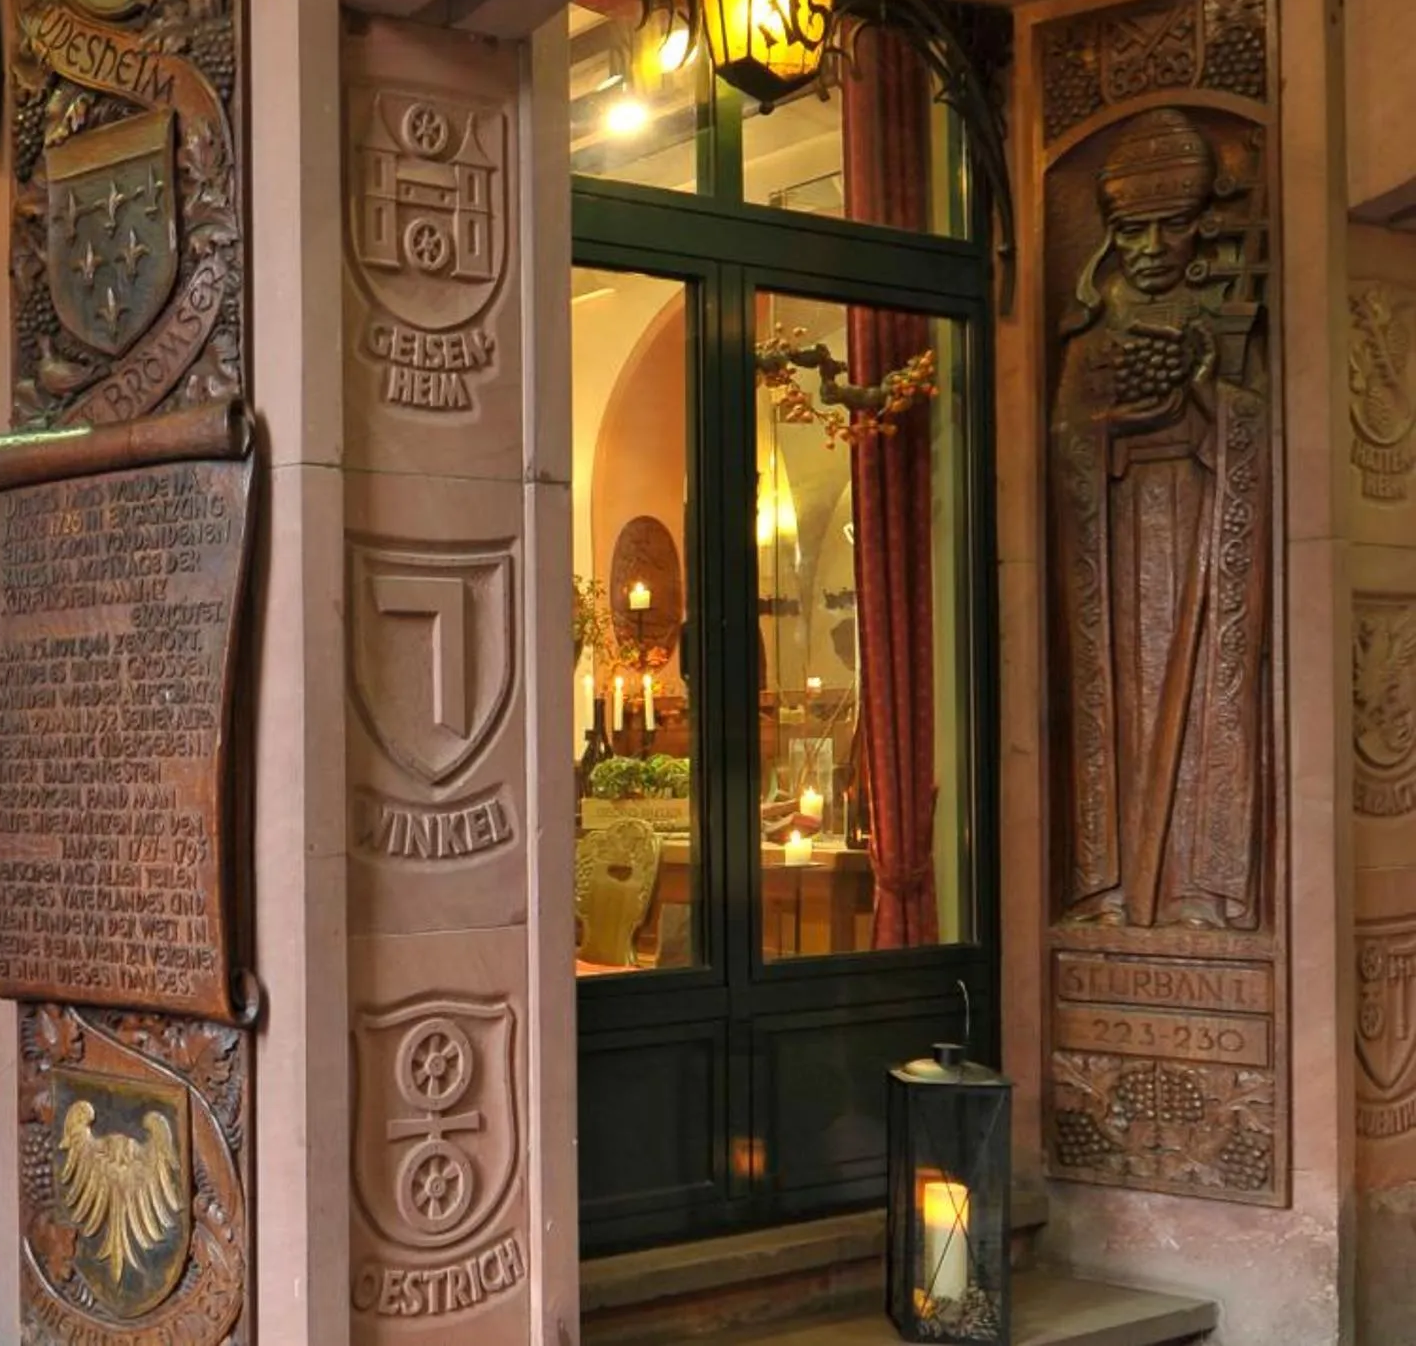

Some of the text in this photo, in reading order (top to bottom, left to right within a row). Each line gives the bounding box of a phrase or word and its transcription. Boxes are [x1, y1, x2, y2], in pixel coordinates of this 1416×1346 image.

[387, 368, 472, 409] HEIM
[355, 797, 515, 859] WINKEL
[1091, 1018, 1245, 1054] 223-230
[352, 1237, 526, 1316] OESTRICH
